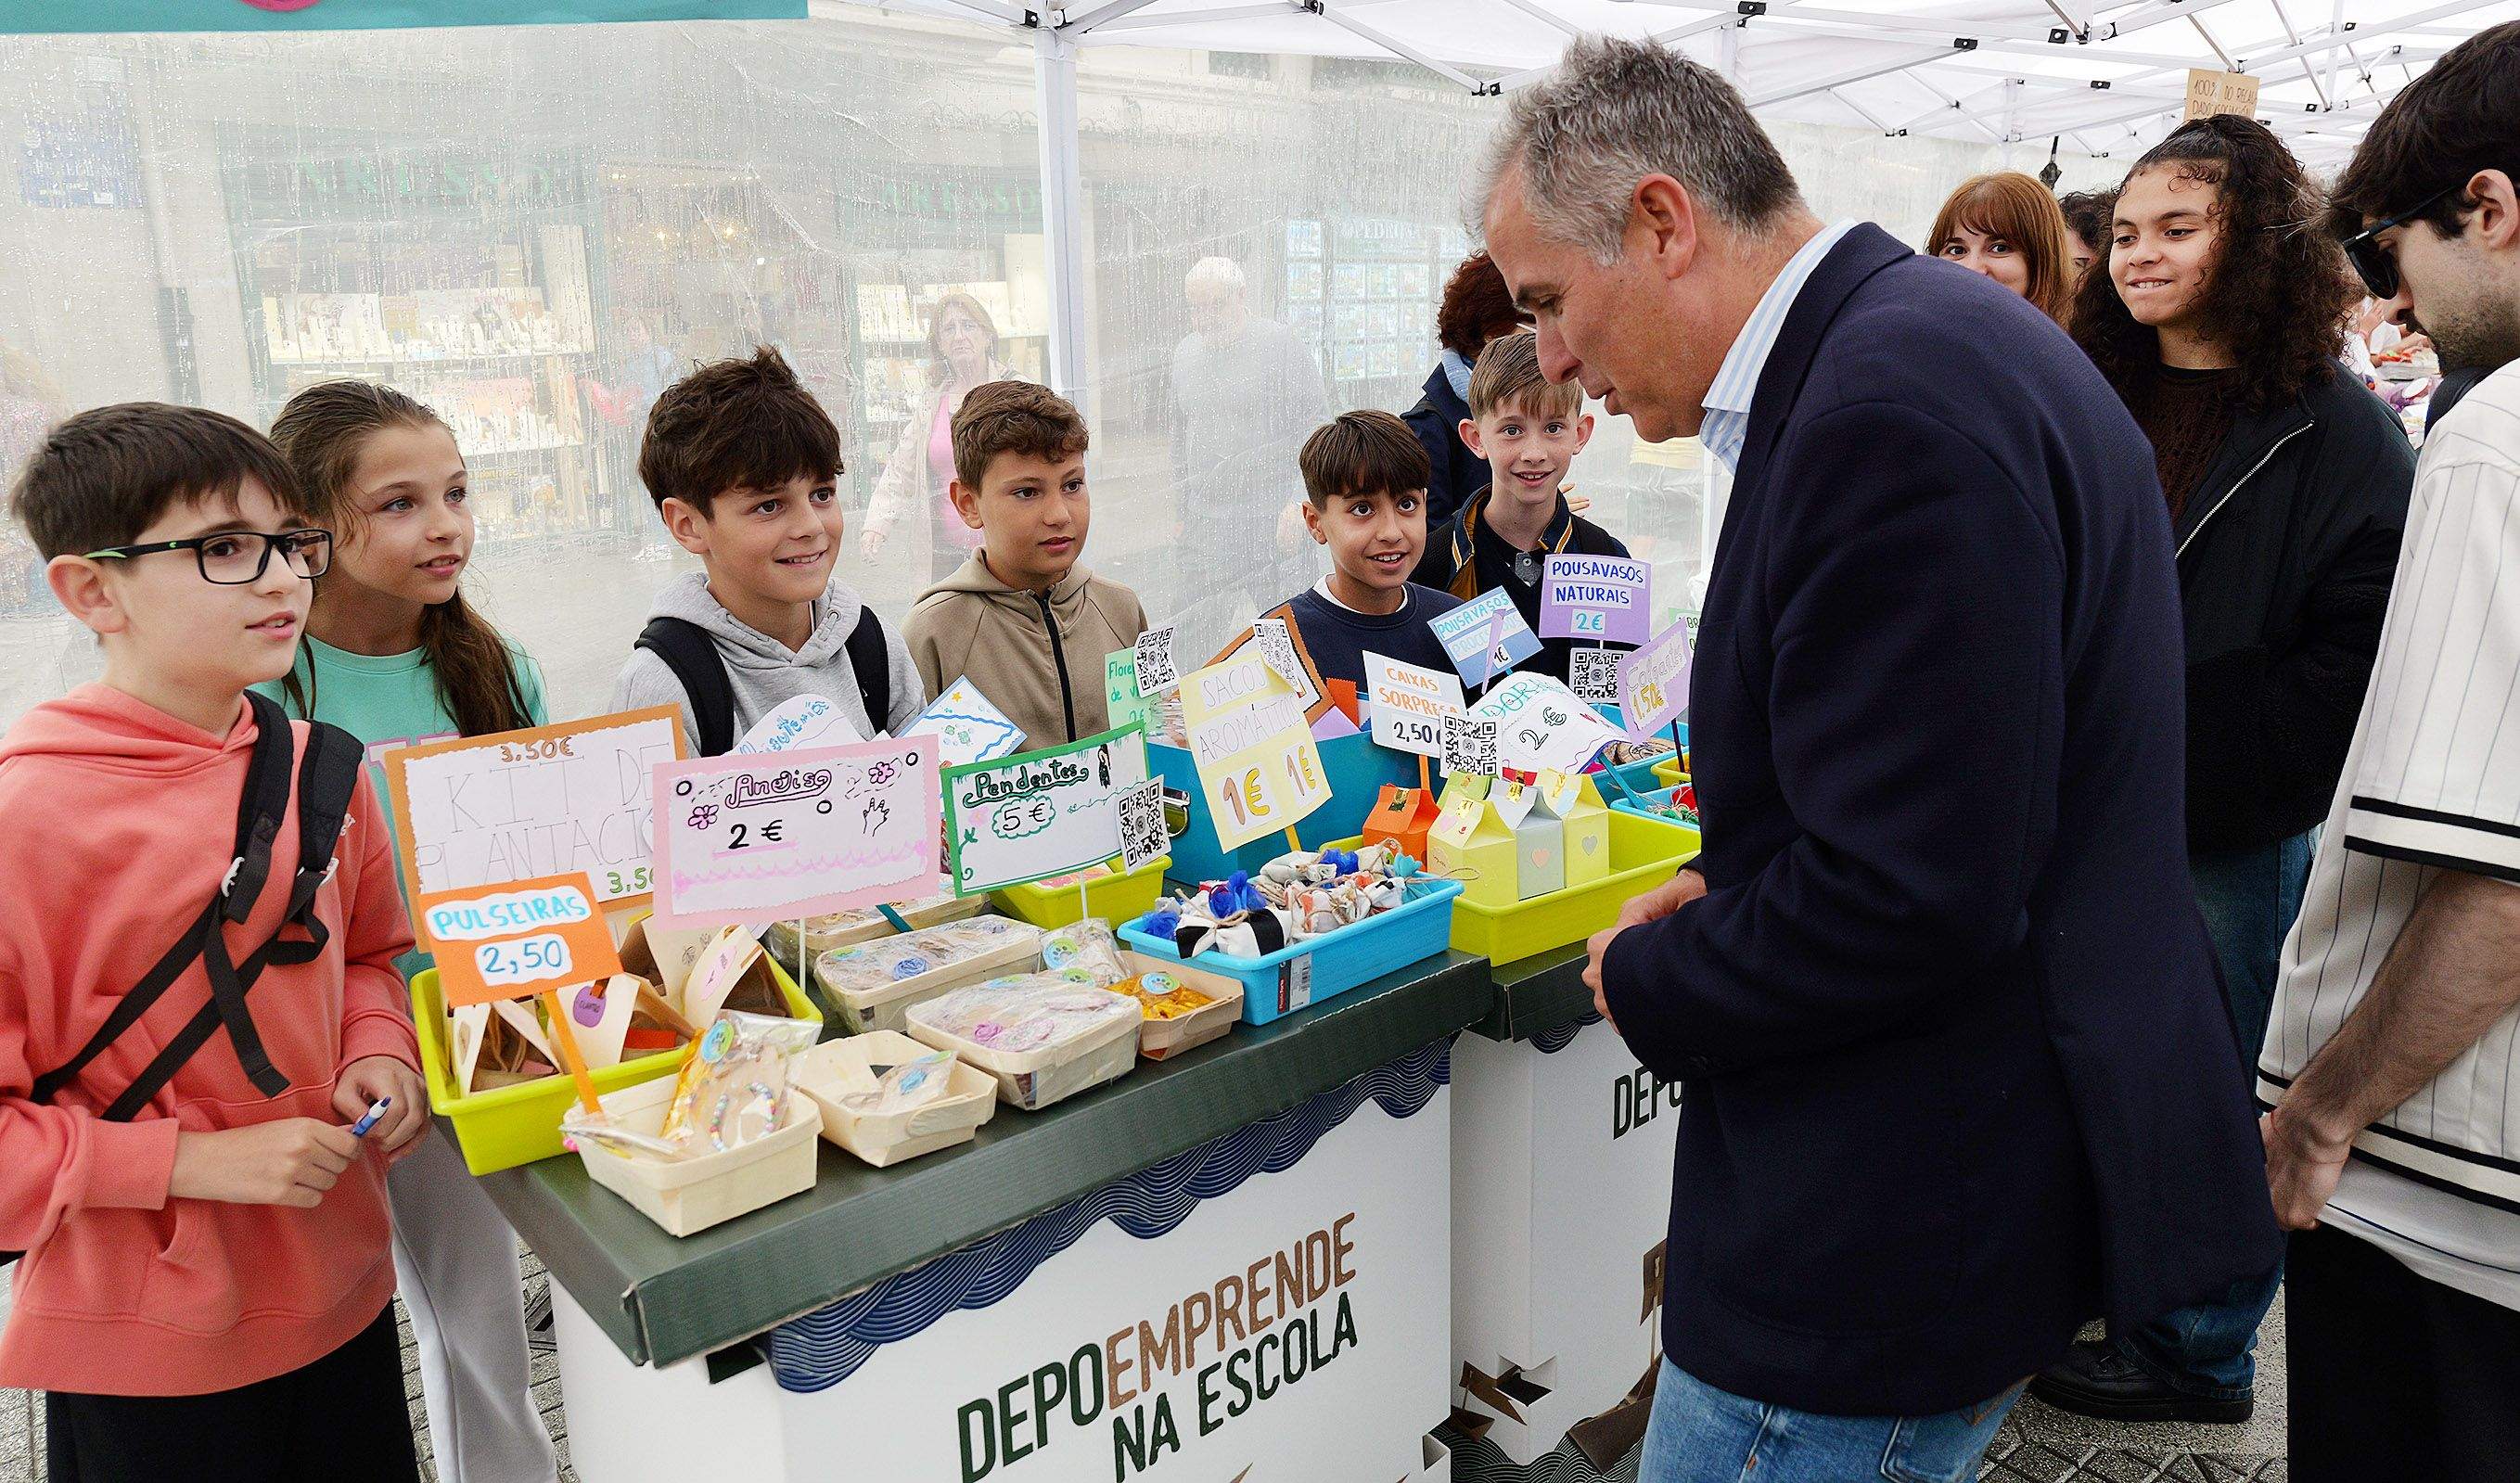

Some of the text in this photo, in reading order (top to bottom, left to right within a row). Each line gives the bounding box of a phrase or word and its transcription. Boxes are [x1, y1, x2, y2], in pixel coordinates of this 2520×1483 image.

[1552, 561, 1644, 583] POUSAVASOS
[1555, 585, 1630, 605] NATURAIS
[1438, 594, 1510, 639] POUSAVASOS
[1575, 612, 1604, 631] 2€
[1108, 660, 1134, 680] Flore
[1493, 646, 1509, 663] 1€
[1110, 686, 1123, 703] de
[1203, 659, 1266, 708] SACOS
[1386, 667, 1439, 692] CAIXAS
[443, 755, 585, 834] KIT
[973, 759, 1080, 799] Pendentes
[1222, 767, 1271, 825] 1€
[1003, 805, 1021, 832] 5
[728, 823, 750, 850] 2
[431, 895, 588, 936] PULSEIRAS
[480, 939, 563, 975] 2,50
[956, 1211, 1357, 1483] DEPOEMPRENDE
[1113, 1291, 1358, 1483] NA ESCOLA
